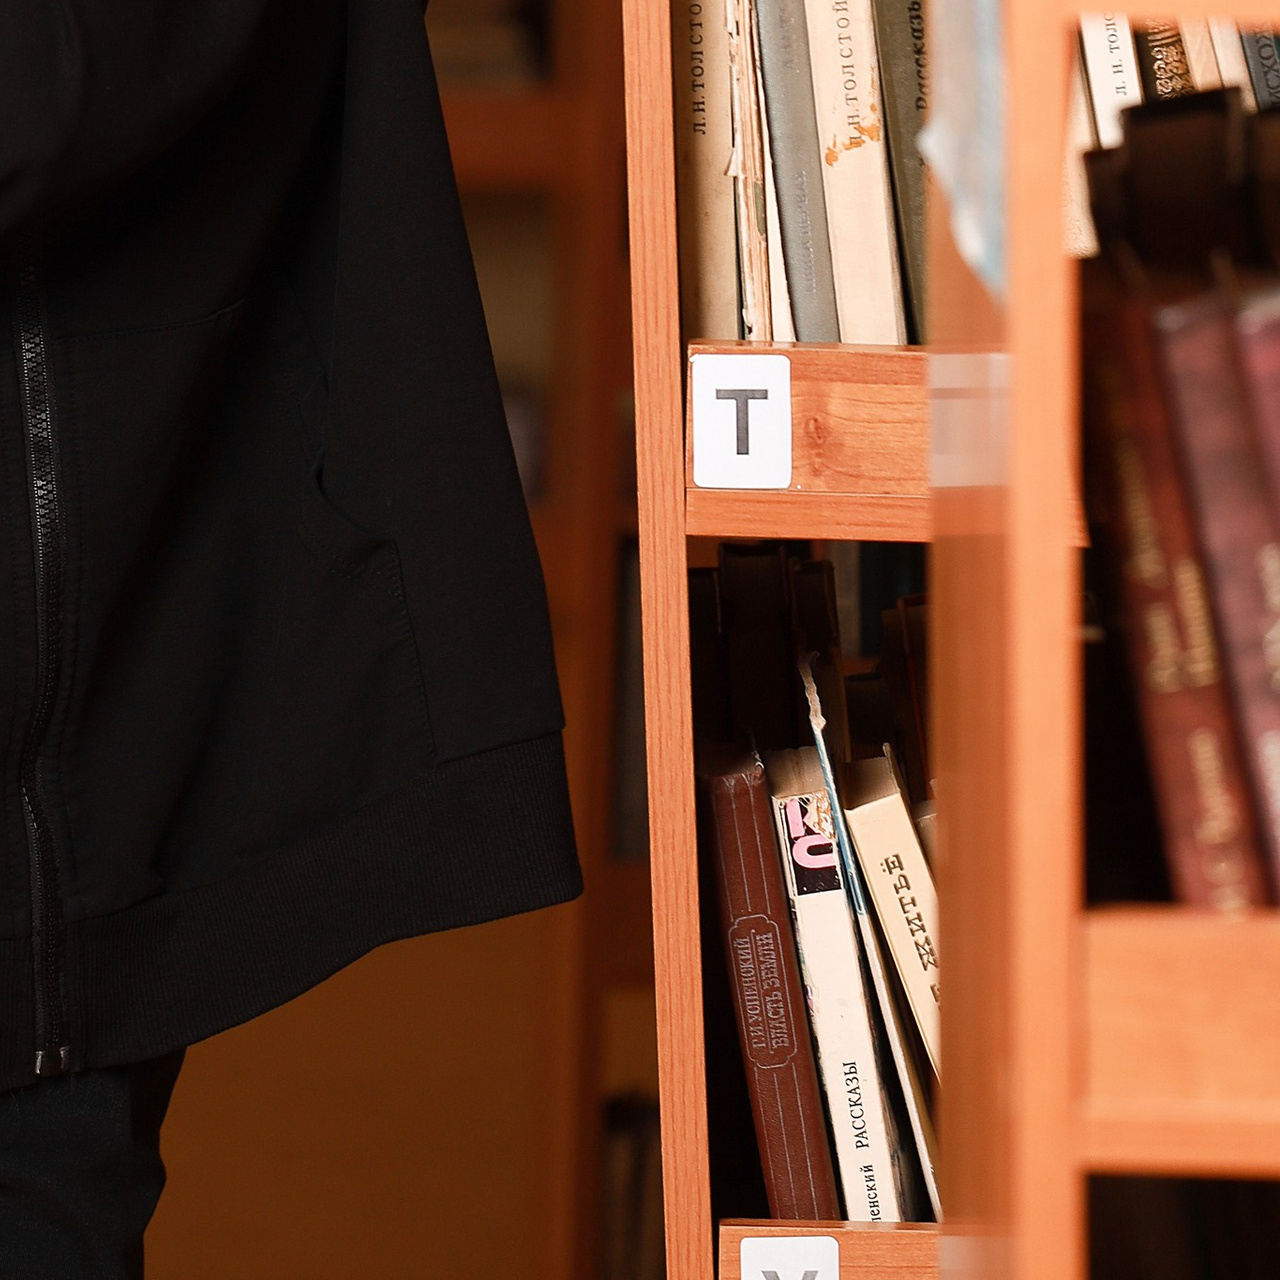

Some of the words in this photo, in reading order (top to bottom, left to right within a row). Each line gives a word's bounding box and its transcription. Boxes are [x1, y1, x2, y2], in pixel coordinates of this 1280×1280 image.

[715, 388, 768, 456] Т
[756, 931, 781, 990] ЗЕМЛИ
[765, 990, 790, 1049] ВЛАСТЬ
[842, 1060, 870, 1149] РАССКАЗЫ
